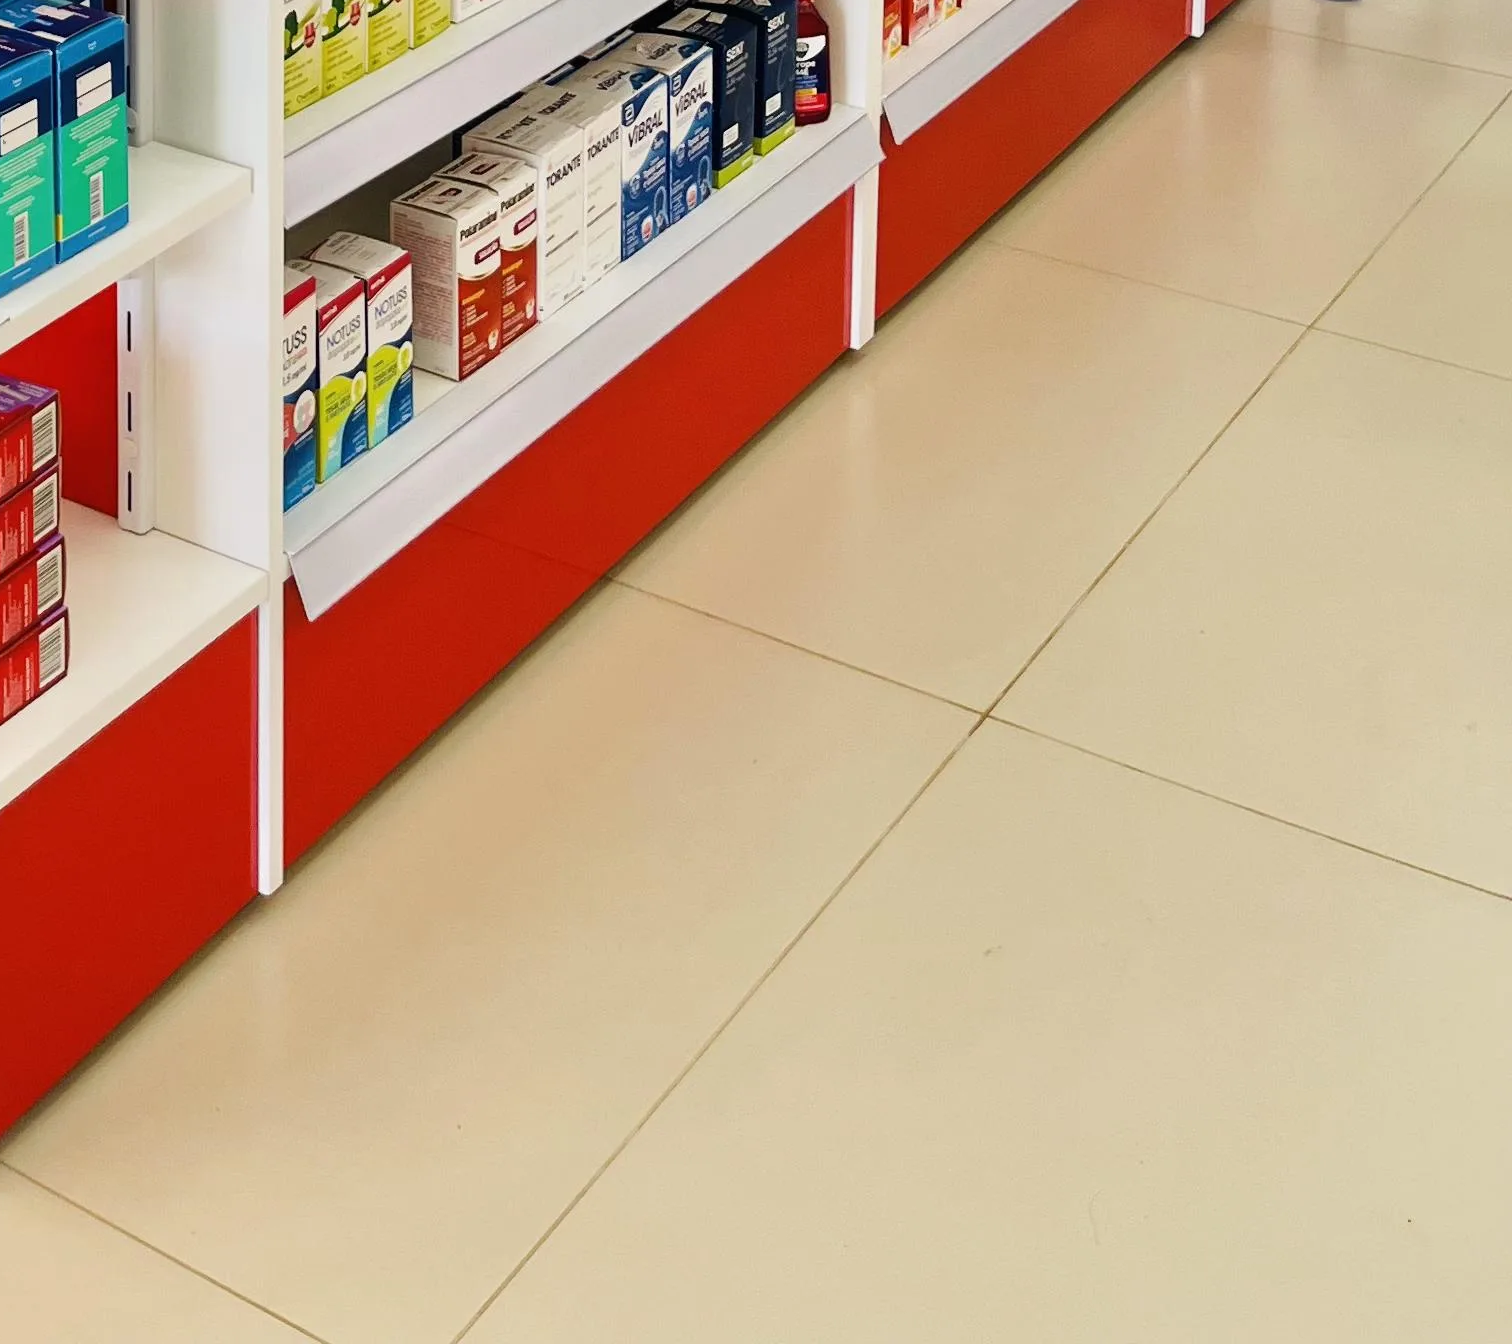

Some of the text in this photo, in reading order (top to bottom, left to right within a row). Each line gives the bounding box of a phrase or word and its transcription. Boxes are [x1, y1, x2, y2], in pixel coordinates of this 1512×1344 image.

[674, 80, 708, 117] VIBRAL
[587, 127, 620, 160] TORANTE
[628, 110, 663, 147] VIBRAL
[546, 155, 582, 190] TORANTE
[374, 285, 408, 320] NOTUSS
[326, 314, 361, 351] NOTUSS
